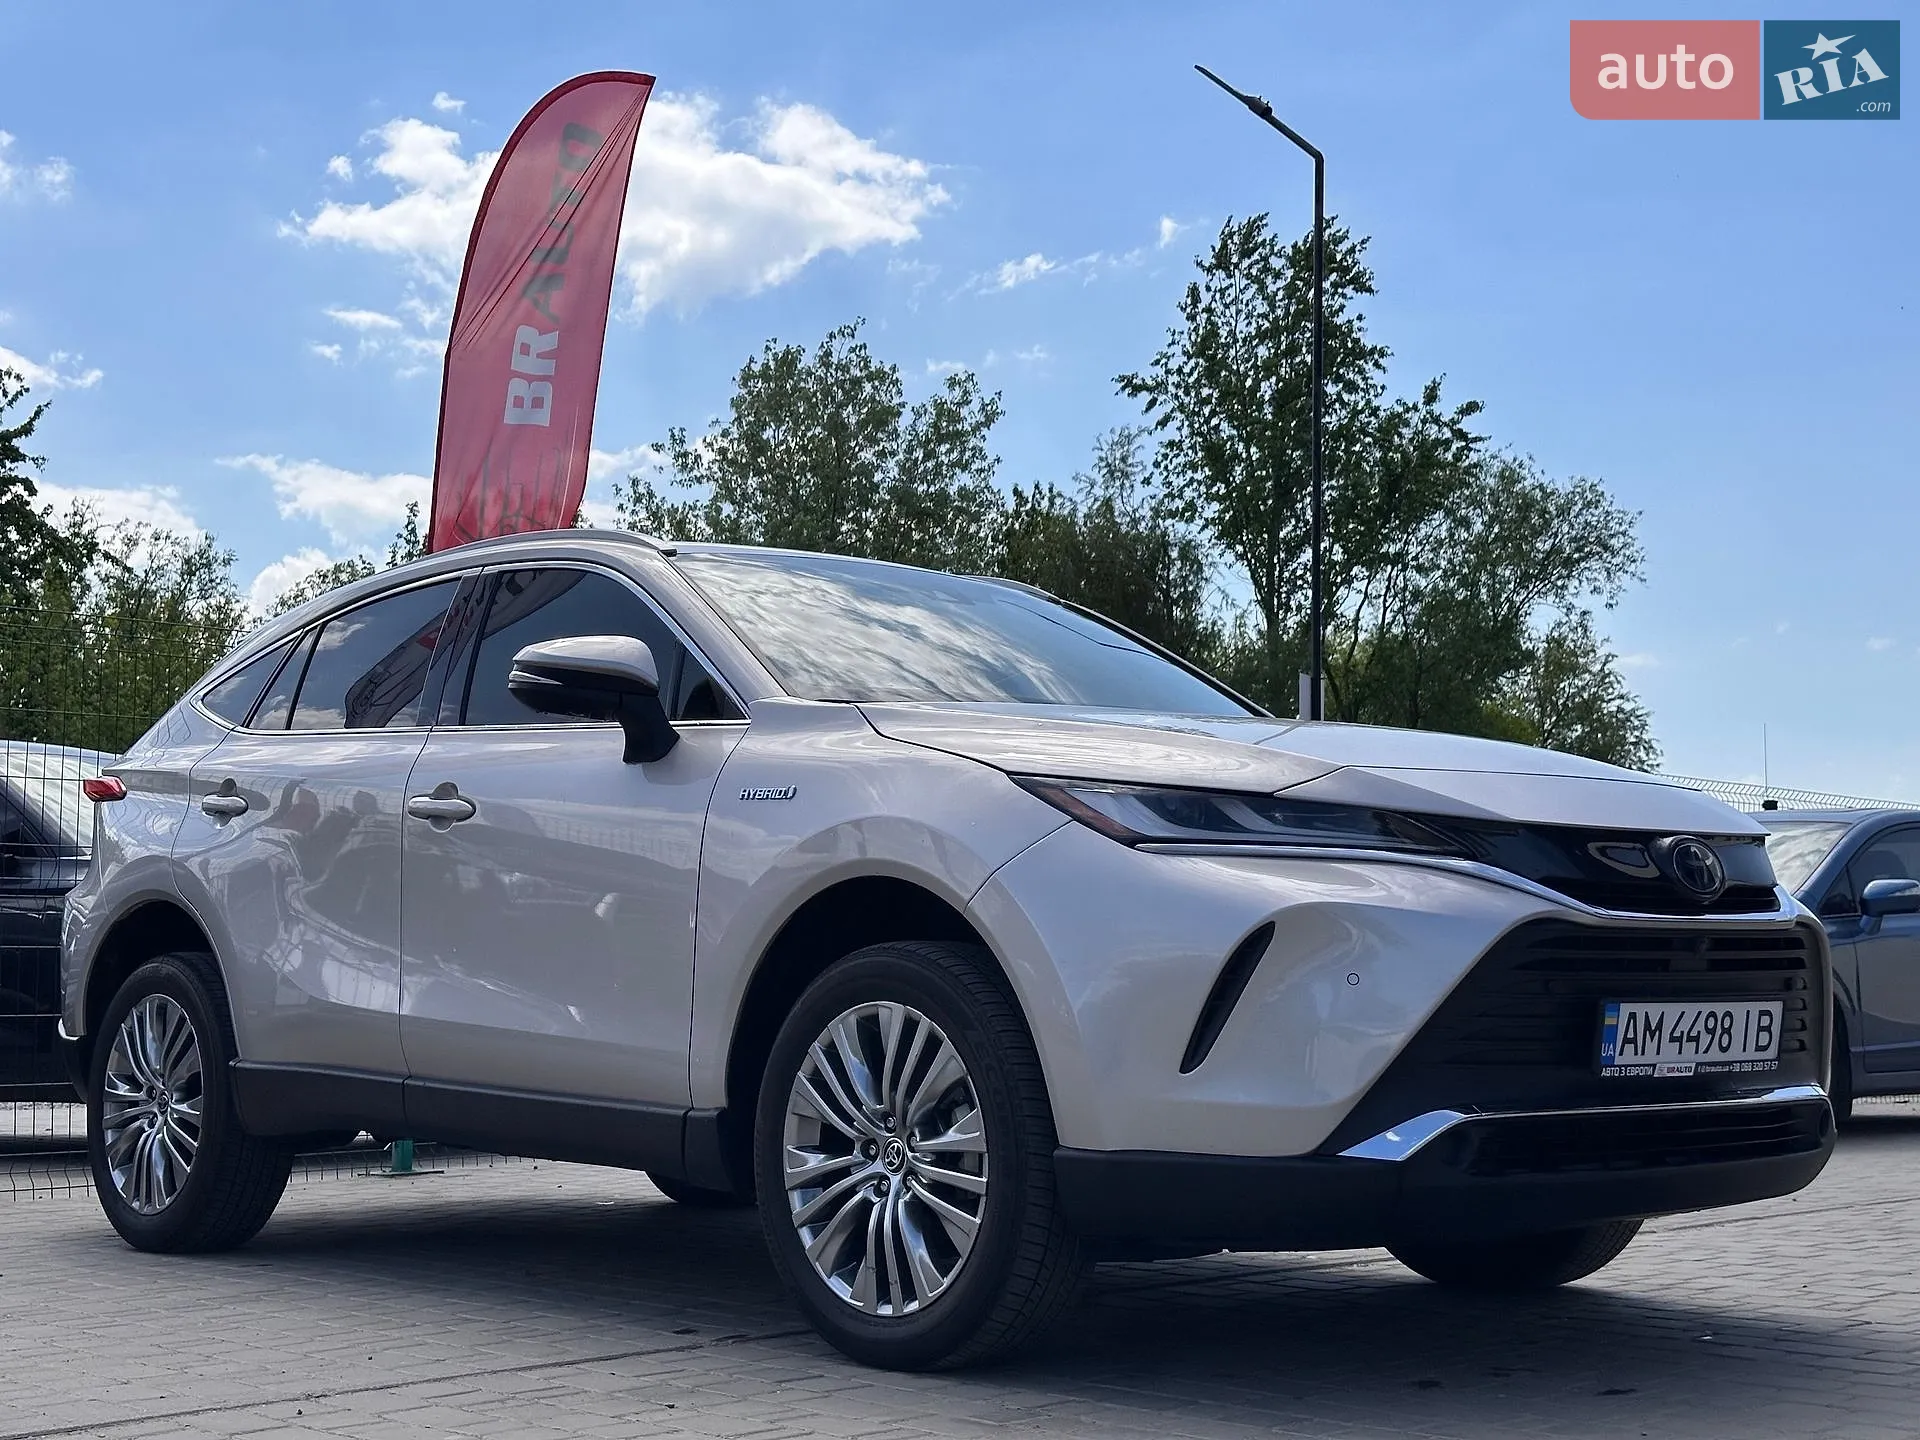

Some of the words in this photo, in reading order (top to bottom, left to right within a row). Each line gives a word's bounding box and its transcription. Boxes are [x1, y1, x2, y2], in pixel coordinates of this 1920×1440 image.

[1618, 1010, 1665, 1056] AM
[1668, 1010, 1734, 1055] 4498
[1742, 1009, 1774, 1053] IB
[1601, 1043, 1614, 1057] UA
